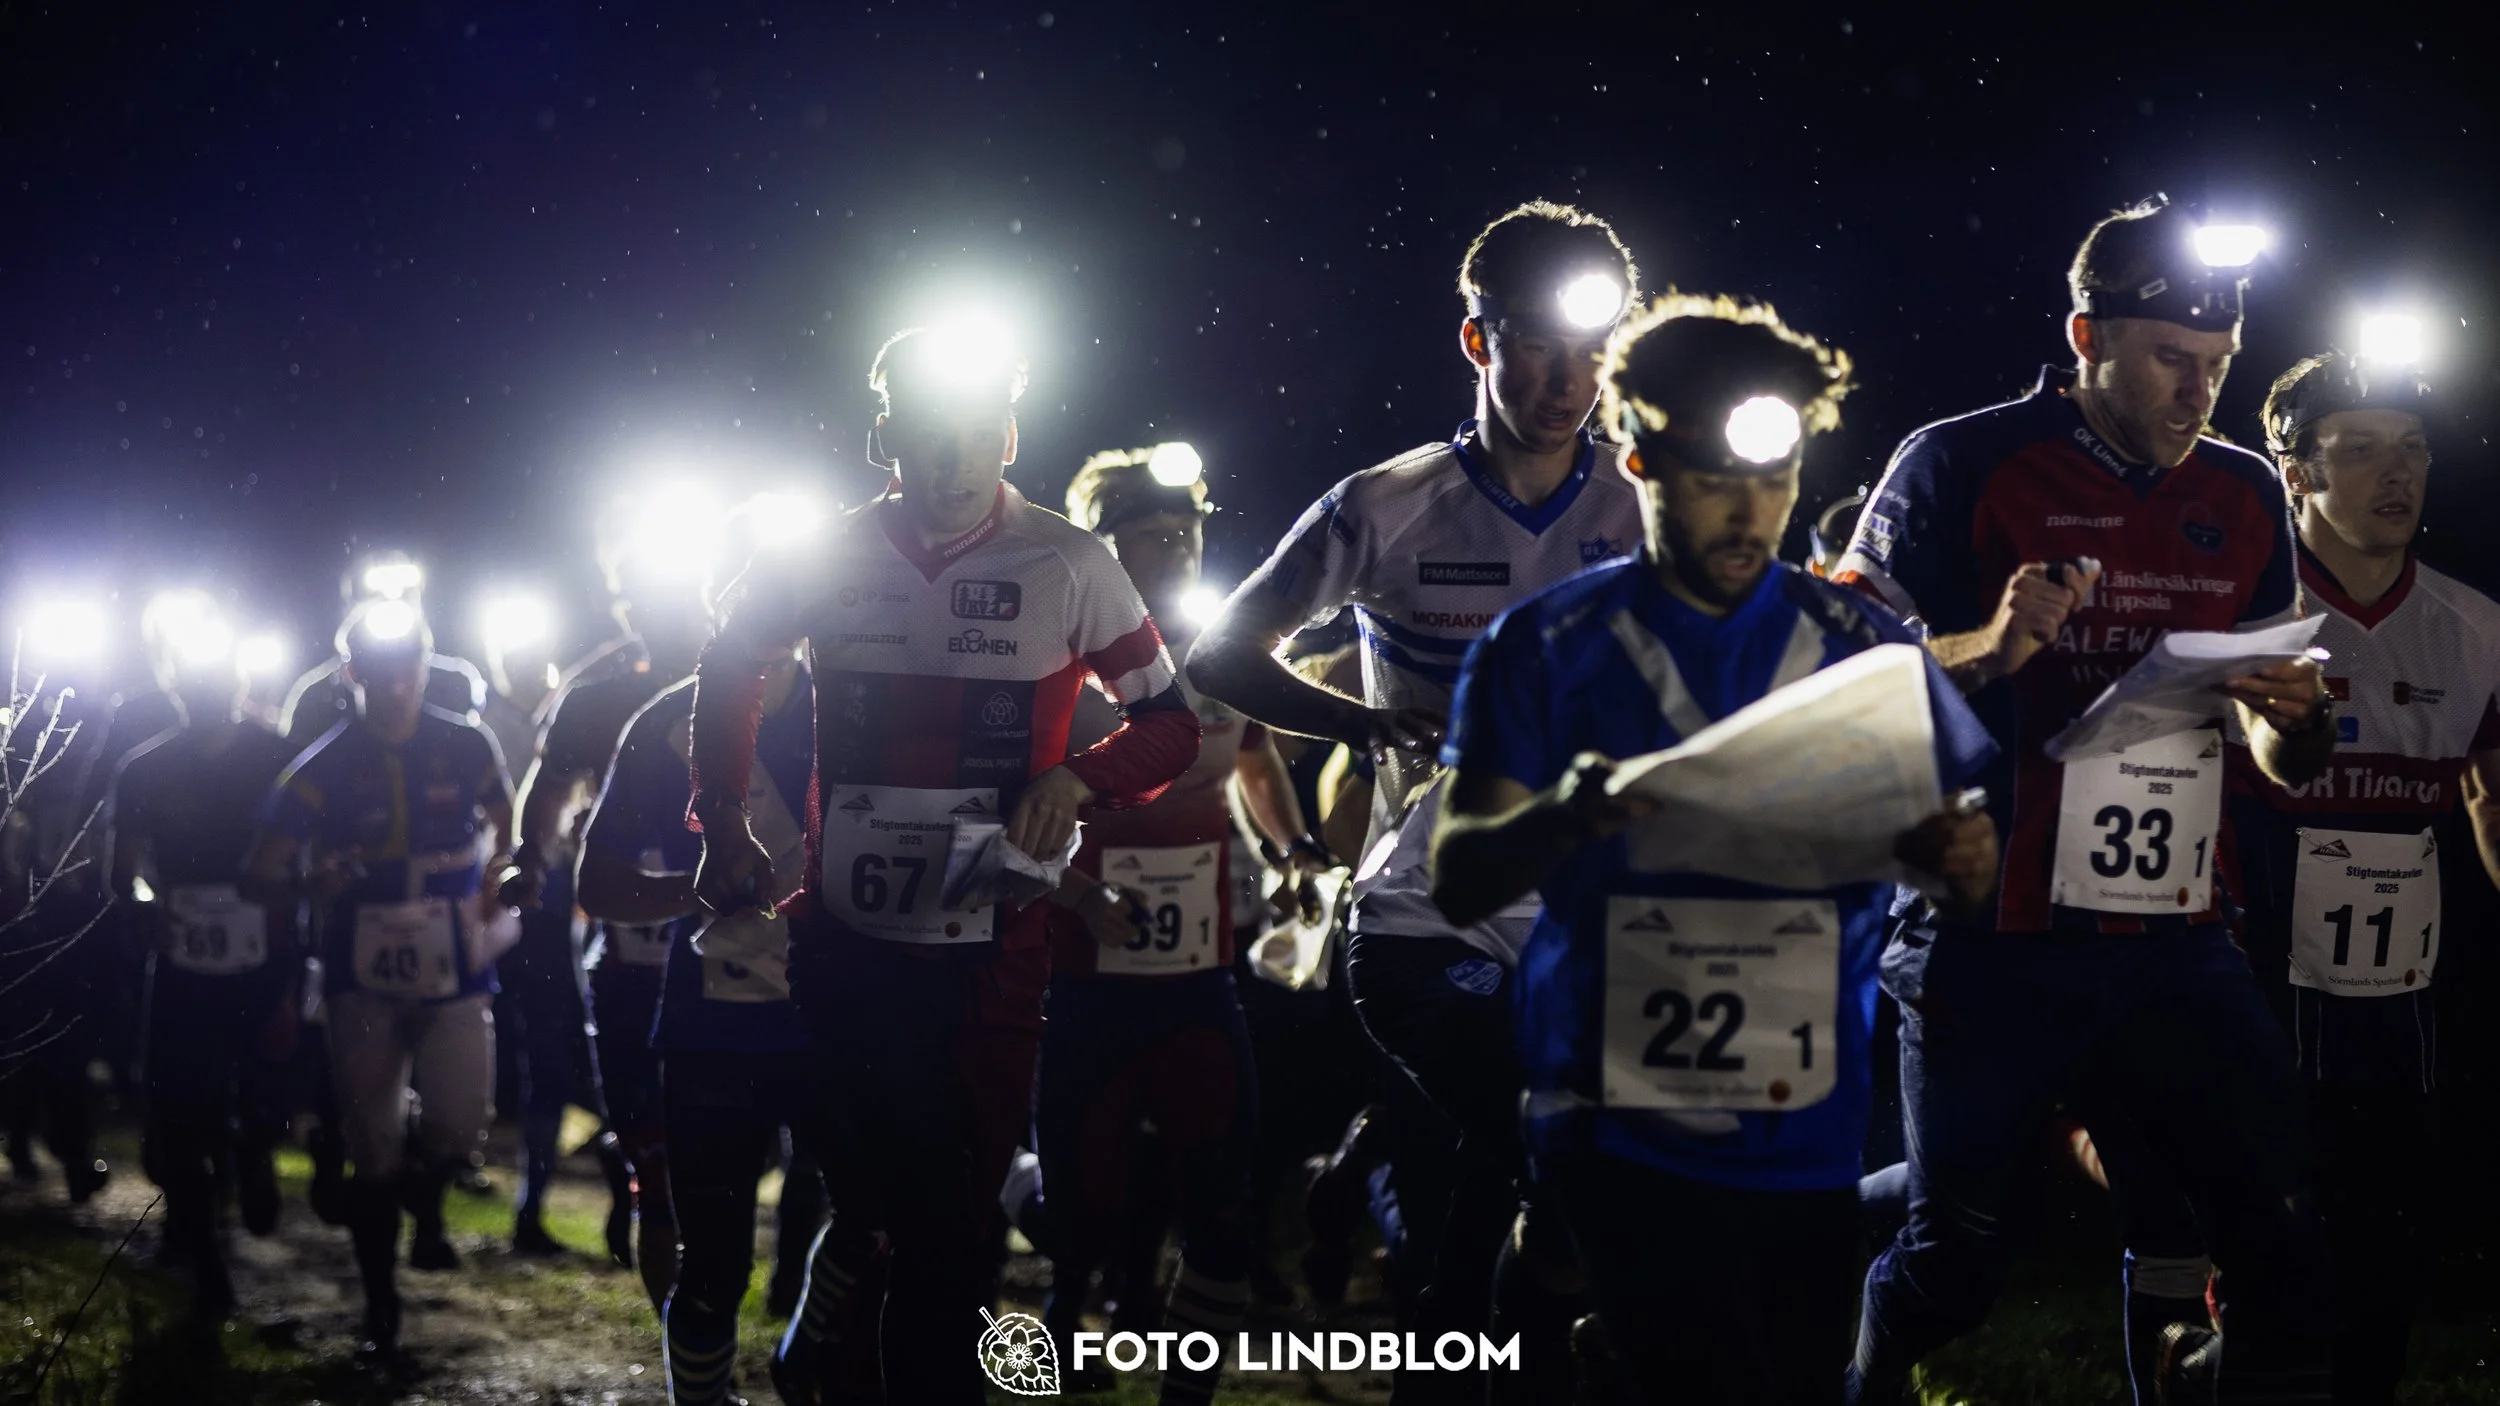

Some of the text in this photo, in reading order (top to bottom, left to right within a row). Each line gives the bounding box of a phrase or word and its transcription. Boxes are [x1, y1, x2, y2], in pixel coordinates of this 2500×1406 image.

[2074, 427, 2097, 448] OK
[1424, 567, 1506, 581] FM Mattsson
[898, 834, 923, 846] 2025
[2091, 804, 2207, 881] 33 1
[852, 853, 928, 915] 67
[2374, 882, 2399, 894] 2025
[1199, 917, 1209, 945] 1
[2324, 904, 2432, 967] 11 1
[1642, 989, 1812, 1071] 22 1
